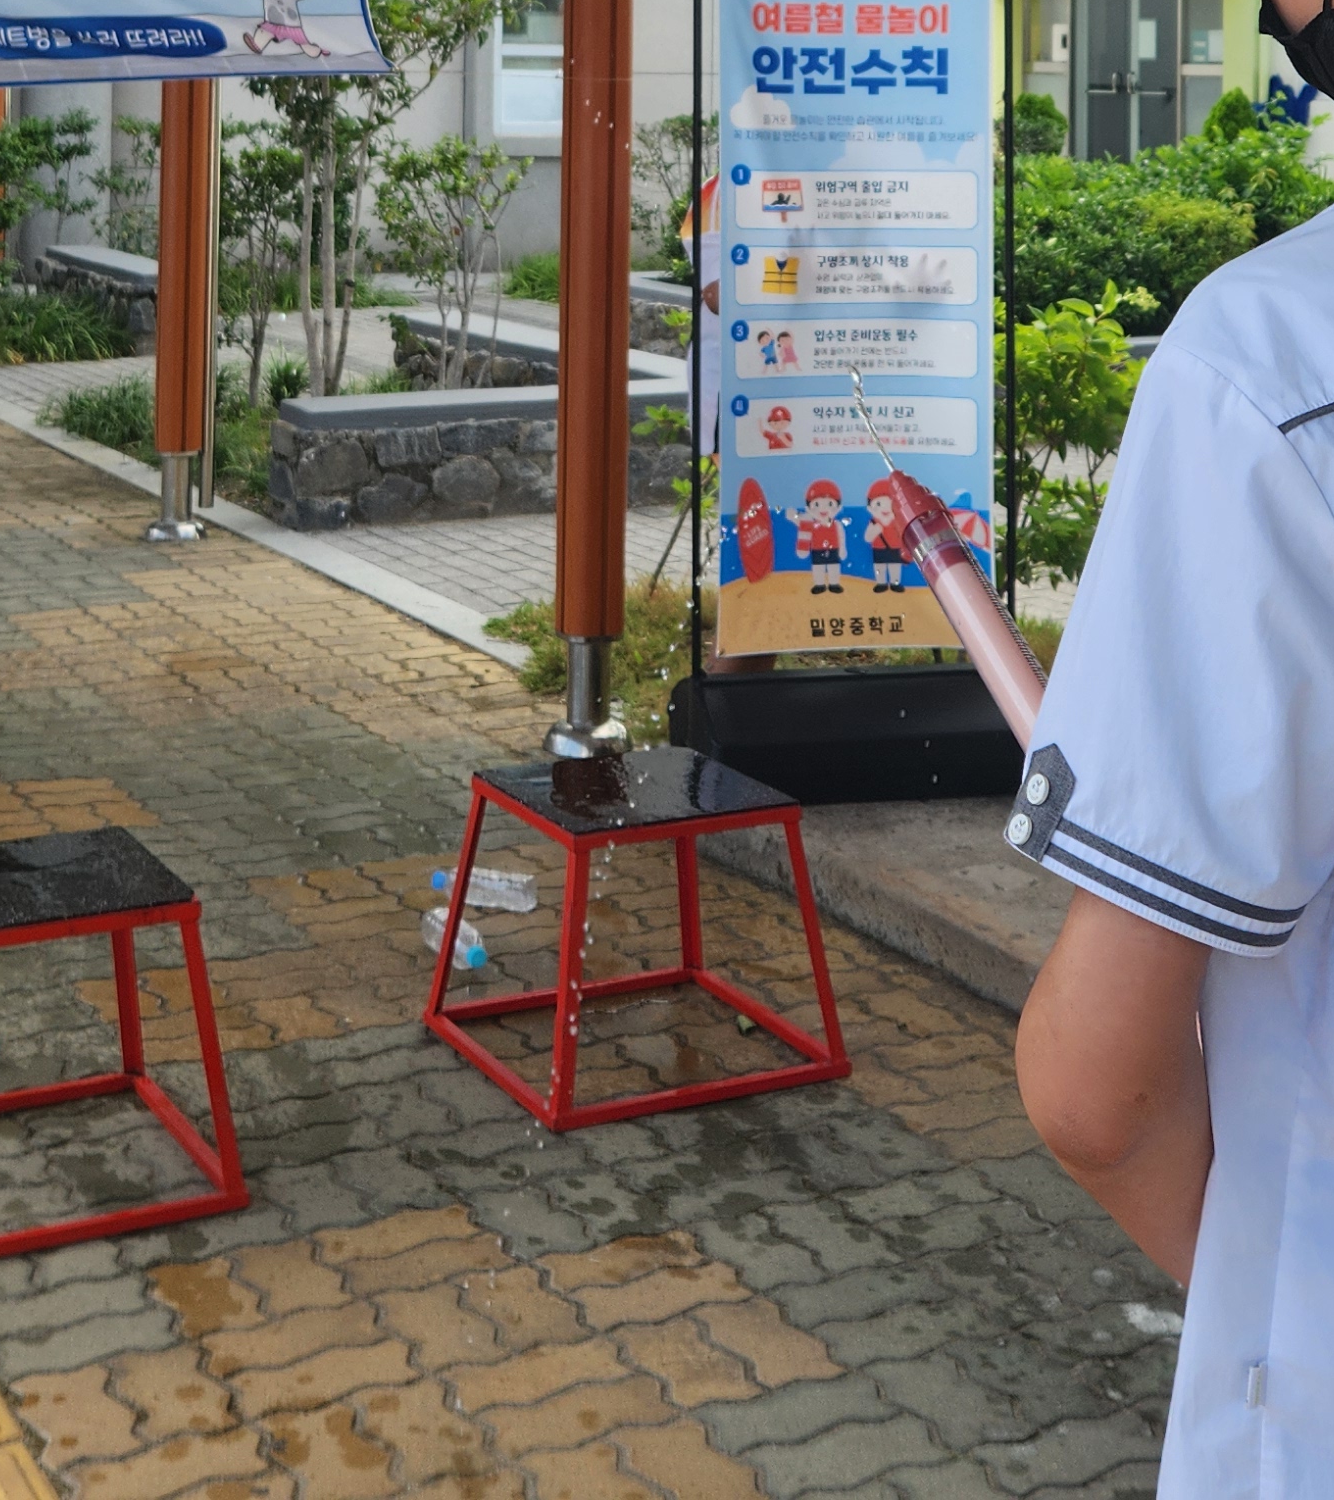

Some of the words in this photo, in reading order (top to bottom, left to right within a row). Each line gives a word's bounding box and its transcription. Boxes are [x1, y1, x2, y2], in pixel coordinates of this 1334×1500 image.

[750, 1, 844, 35] 여름철
[855, 1, 949, 35] 물놀이
[752, 45, 949, 95] 안전수칙
[738, 168, 744, 180] 1
[815, 180, 857, 193] 위험구역
[862, 180, 882, 193] 출입
[887, 180, 909, 193] 금지
[736, 249, 744, 260] 2
[817, 255, 859, 267] 구명조끼
[861, 255, 883, 267] 상시
[887, 255, 909, 267] 착용
[736, 326, 744, 337] 3
[814, 329, 847, 342] 입수전
[850, 329, 892, 342] 준비운동
[896, 329, 919, 342] 필수
[812, 406, 846, 419] 익수자
[876, 406, 888, 419] 시
[892, 406, 915, 419] 신고
[810, 616, 905, 638] 밀양중학교
